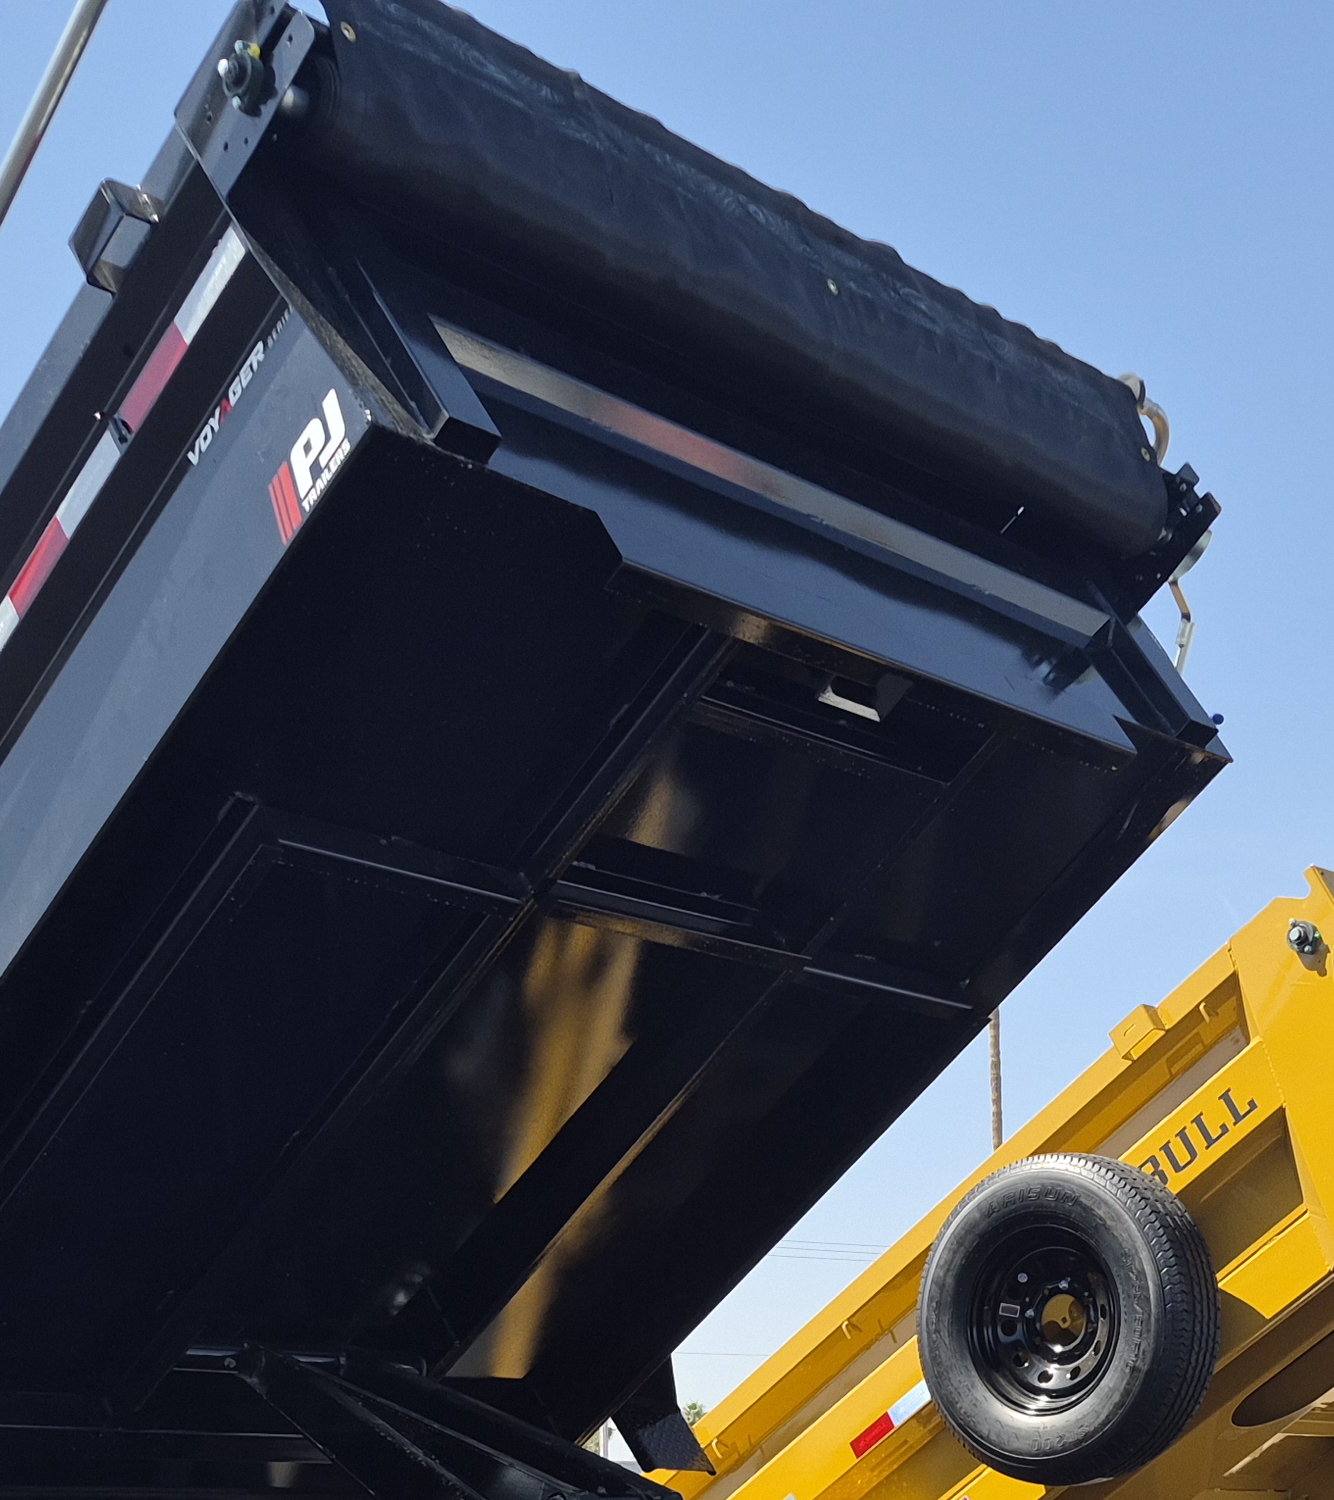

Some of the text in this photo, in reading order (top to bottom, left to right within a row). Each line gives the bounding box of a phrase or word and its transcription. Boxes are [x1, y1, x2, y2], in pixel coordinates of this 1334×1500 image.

[186, 340, 265, 467] VOYAGER
[290, 387, 347, 500] PJ
[301, 437, 352, 513] TRAILERS
[985, 1185, 1082, 1219] ARISUN
